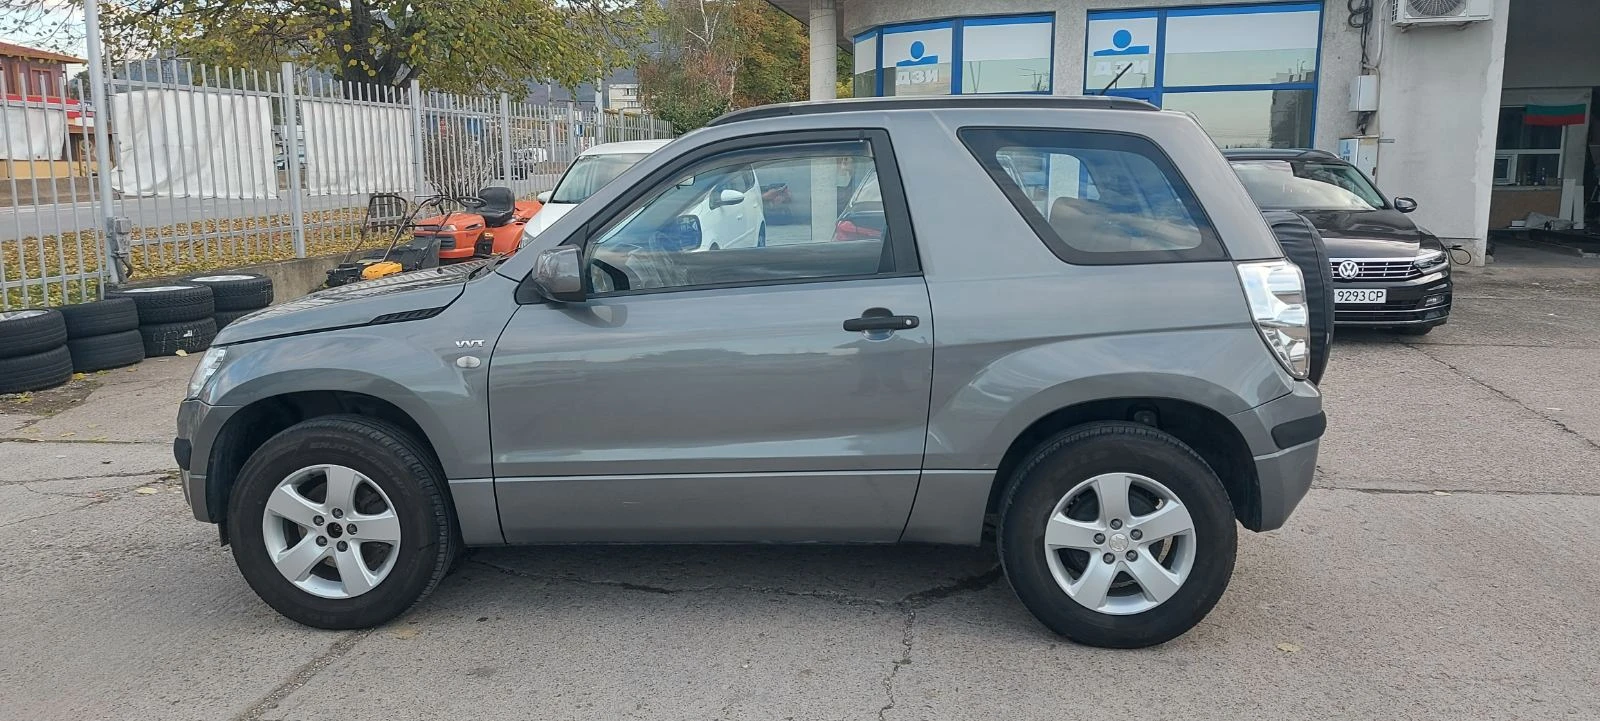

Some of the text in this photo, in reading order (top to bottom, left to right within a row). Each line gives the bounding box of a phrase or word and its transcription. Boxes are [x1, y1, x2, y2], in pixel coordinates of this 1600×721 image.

[896, 69, 938, 85] ДЗИ
[1338, 290, 1384, 302] 9293 CP
